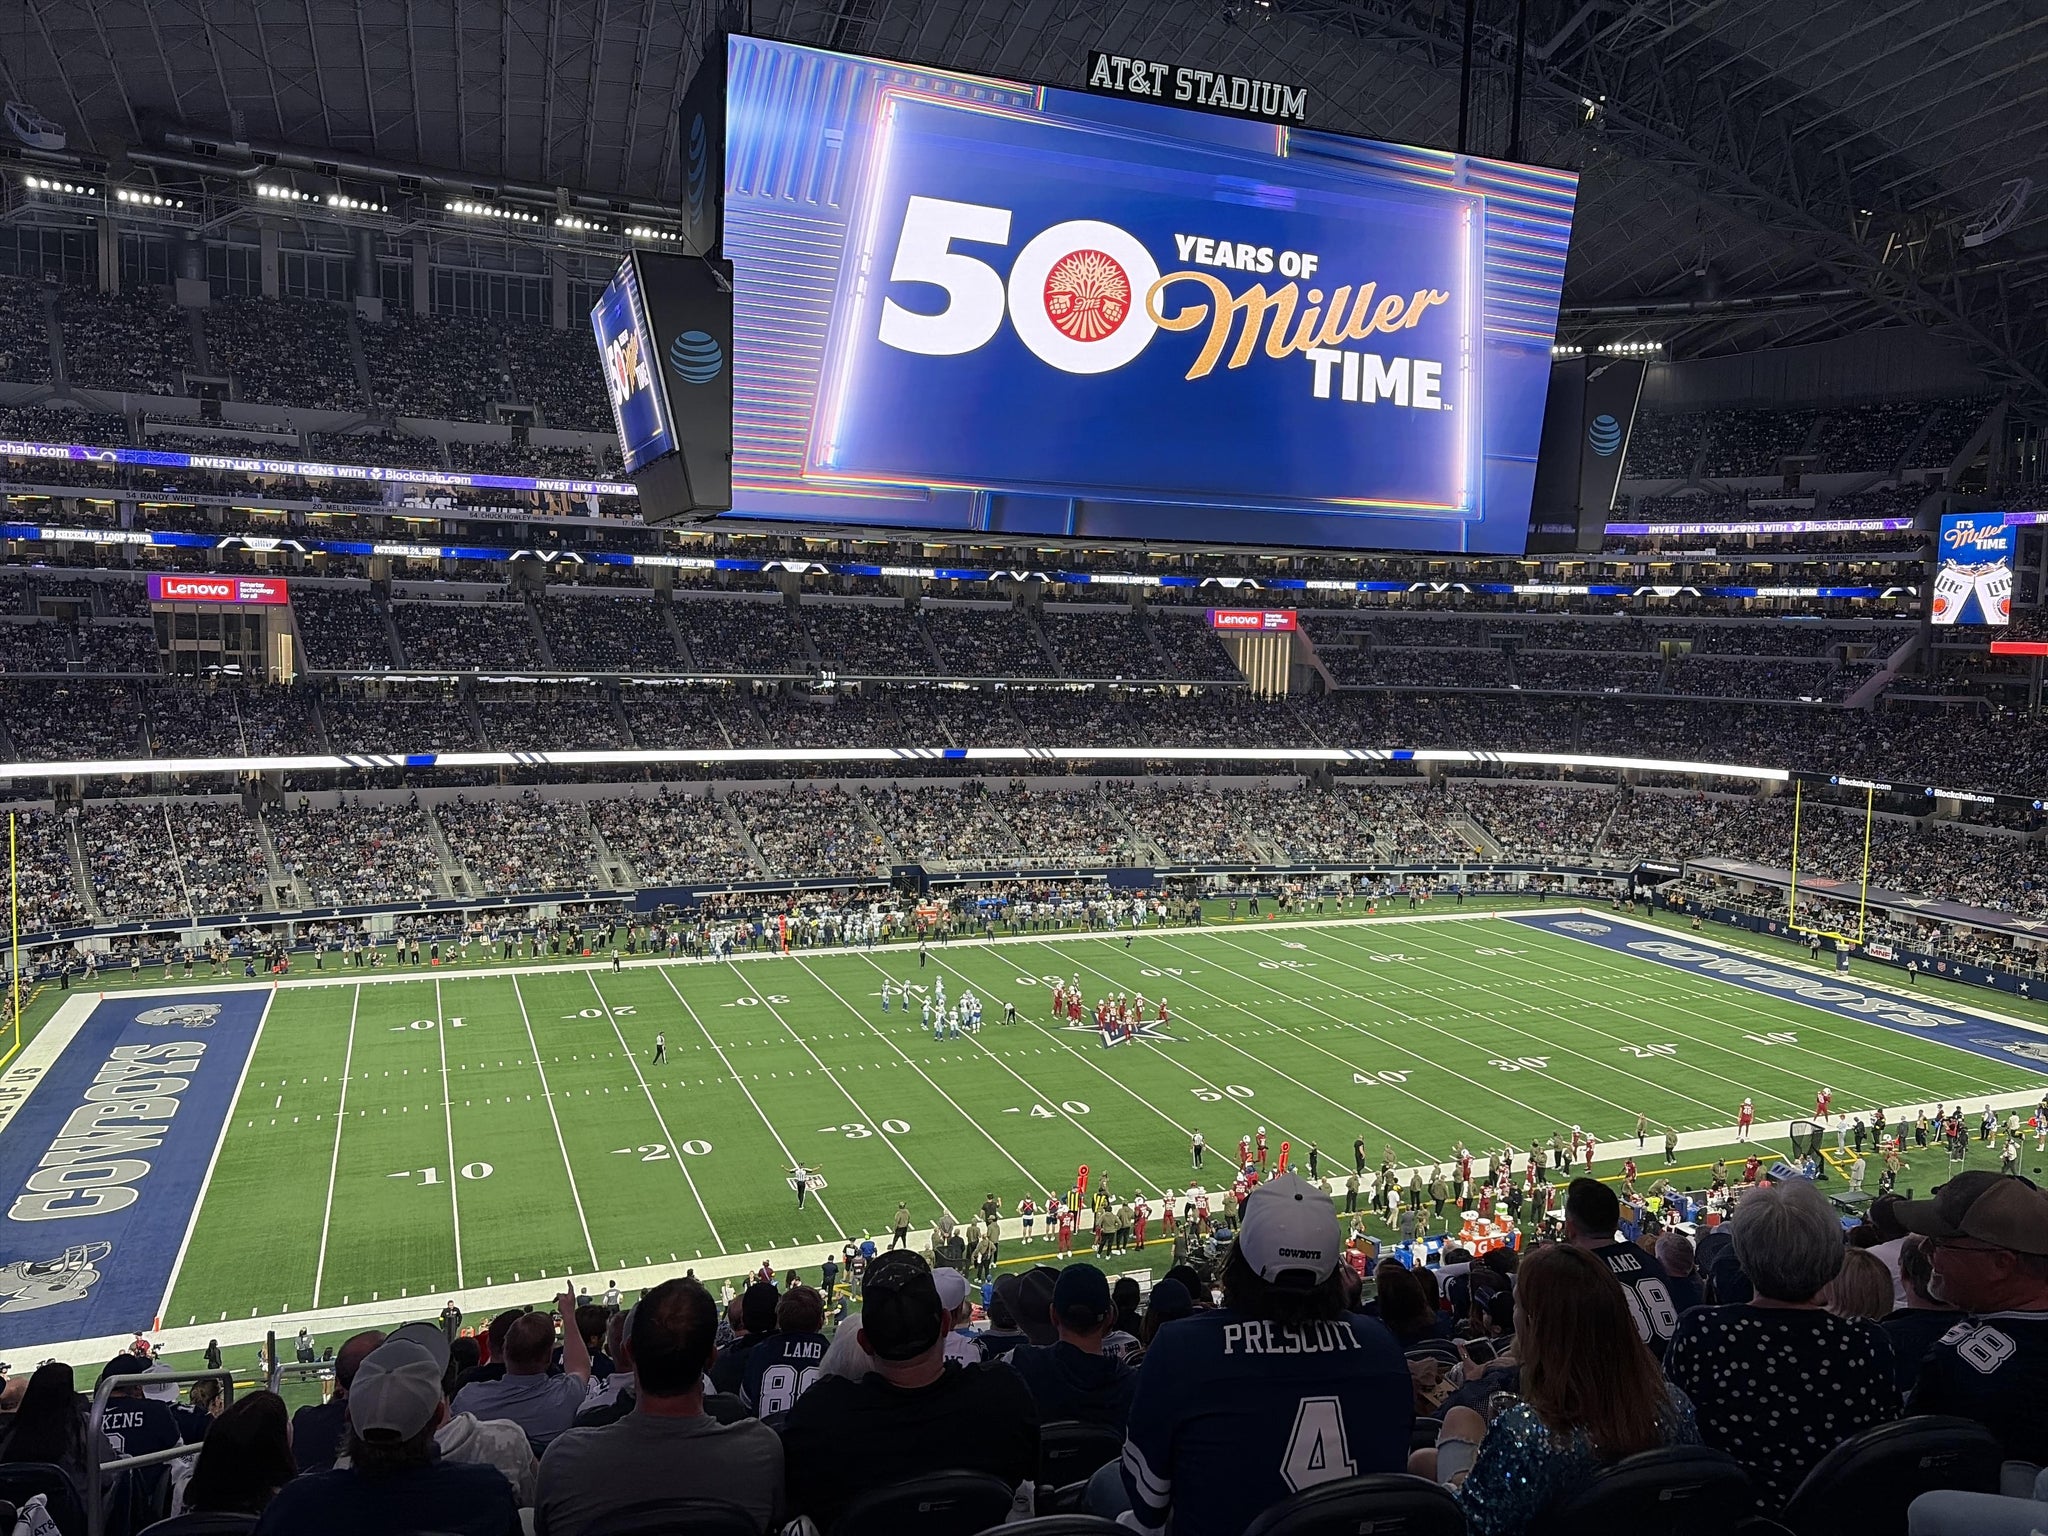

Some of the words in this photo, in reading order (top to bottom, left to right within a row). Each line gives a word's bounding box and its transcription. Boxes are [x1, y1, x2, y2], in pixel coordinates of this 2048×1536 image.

[1089, 53, 1169, 97] AT&T
[1175, 67, 1308, 120] STADIUM
[1174, 233, 1274, 273] YEARS
[1271, 248, 1319, 281] OF
[878, 194, 1164, 375] 50
[1146, 271, 1451, 381] Miller
[1305, 347, 1444, 411] TIME
[190, 456, 231, 468] INVEST
[234, 460, 261, 470] LIKE
[263, 462, 296, 474] YOUR
[298, 465, 335, 476] ICONS
[337, 467, 366, 478] WITH
[385, 470, 472, 485] Blockchain.com
[536, 480, 569, 492] INVEST
[572, 482, 593, 493] LIKE
[596, 484, 622, 495] YOUR
[140, 493, 170, 501] RANDY
[343, 505, 371, 513] RENFRO
[1648, 525, 1680, 534] INVEST
[1681, 525, 1701, 534] LIKE
[1703, 525, 1728, 534] YOUR
[1731, 524, 1761, 533] ICONS
[1763, 523, 1787, 532] WITH
[1804, 520, 1883, 531] Blockchain.com
[1956, 520, 1974, 529] IT'S
[103, 532, 126, 541] LOOP
[128, 533, 152, 543] TOUR
[1944, 523, 2008, 550] Miller
[166, 581, 229, 596] Lenovo
[240, 587, 275, 595] technology
[1218, 614, 1258, 625] Lenovo
[1838, 776, 1892, 791] Blockchain.com
[1934, 788, 1995, 804] Blockchain.com
[1870, 948, 1891, 958] MNF
[1626, 940, 1967, 1027] COWBOYS
[5, 1067, 42, 1083] US
[1190, 1083, 1256, 1103] 50
[7, 1040, 208, 1222] COWBOYS
[637, 1138, 714, 1163] 20
[415, 1160, 495, 1187] 10
[1278, 1247, 1322, 1260] COWBOYS
[1223, 1319, 1362, 1355] PRESCOTT
[783, 1341, 822, 1359] LAMB
[1279, 1395, 1358, 1494] 4
